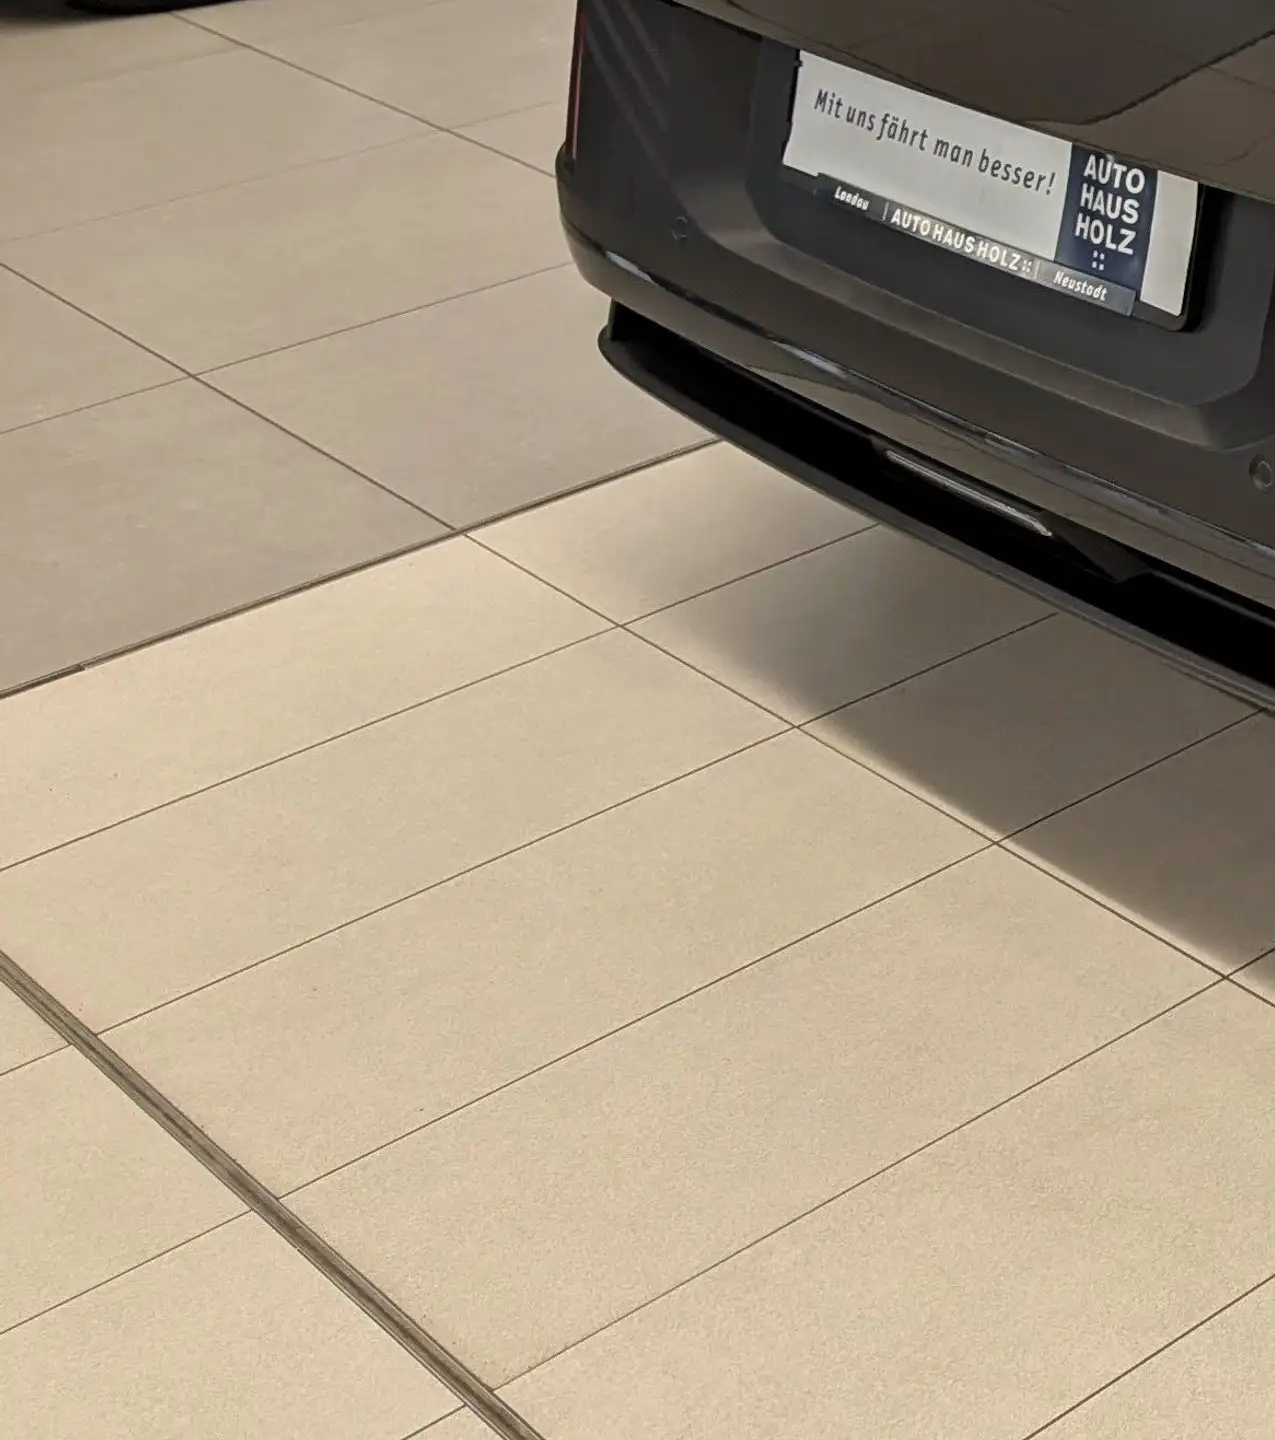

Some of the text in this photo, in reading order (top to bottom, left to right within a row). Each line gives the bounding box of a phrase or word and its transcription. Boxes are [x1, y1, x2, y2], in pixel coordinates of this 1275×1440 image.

[814, 88, 1056, 195] Mit uns fährt man besser!
[1083, 154, 1145, 194] AUTO
[1080, 183, 1140, 224] HAUS
[1075, 212, 1137, 255] HOLZ
[976, 240, 1022, 271] HOLZ
[1053, 270, 1109, 301] Neustadt
